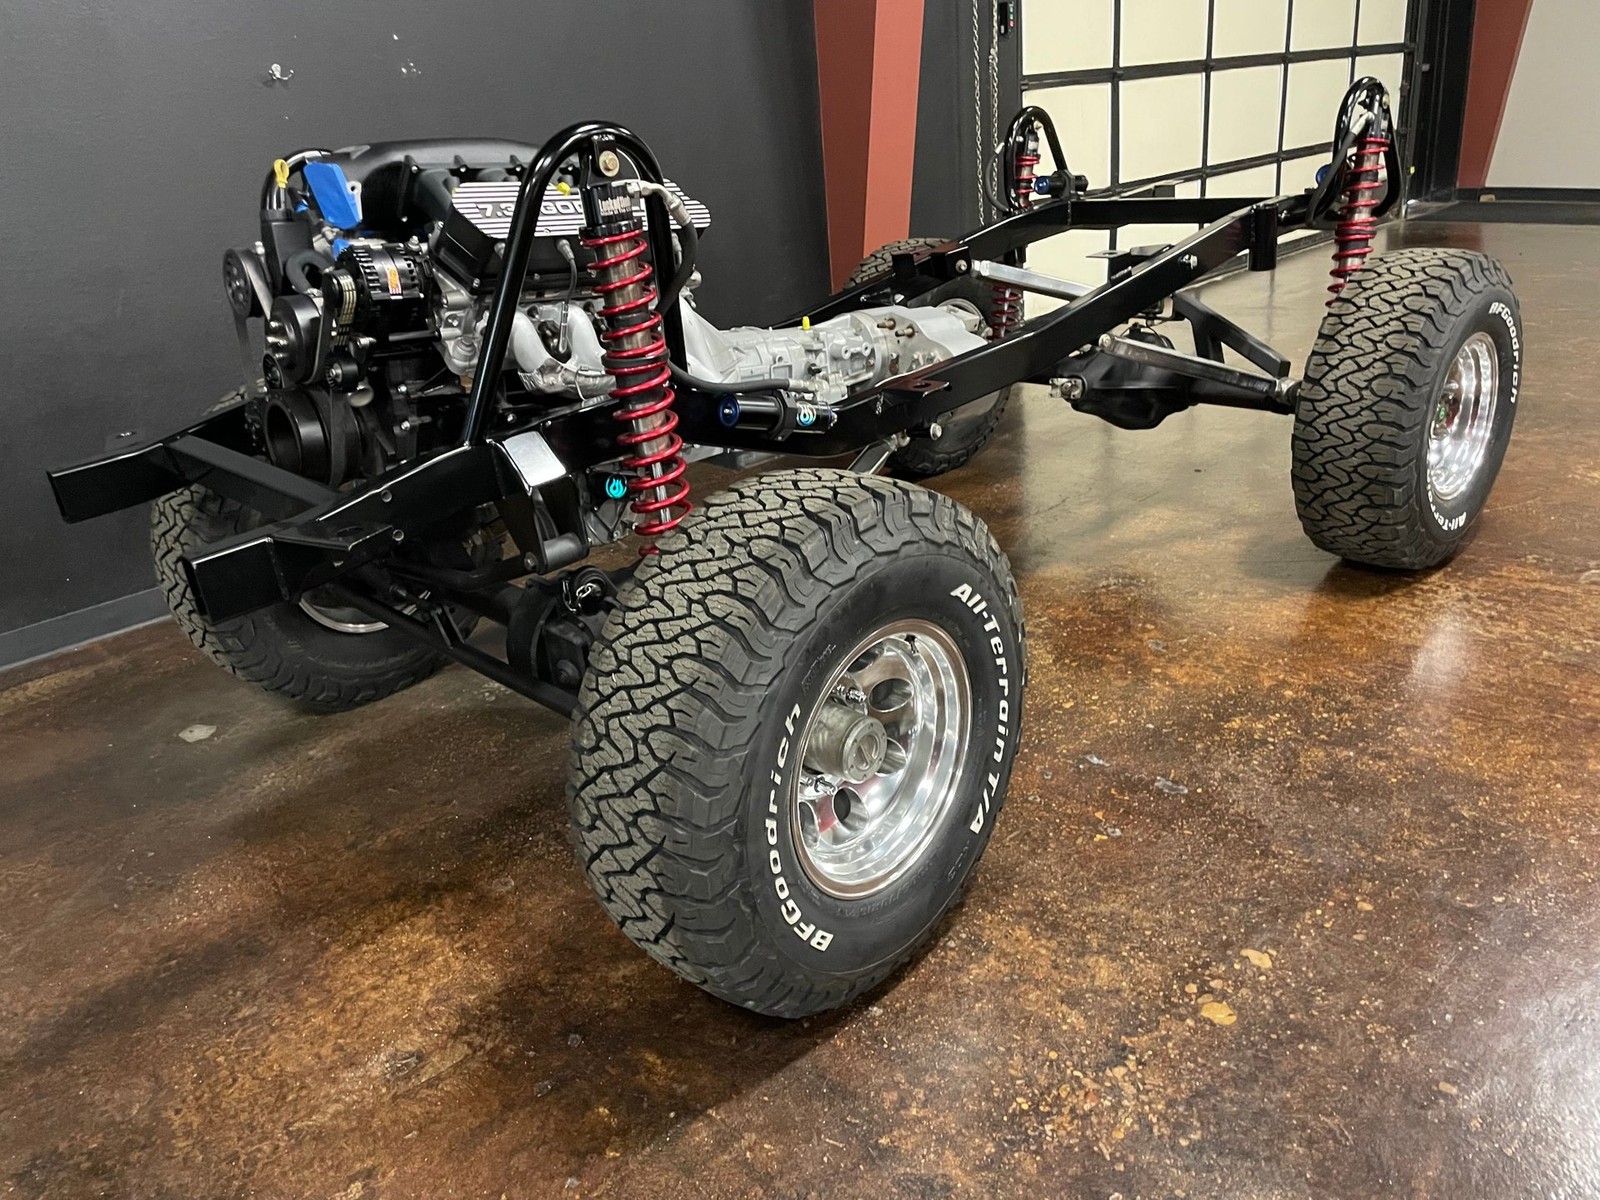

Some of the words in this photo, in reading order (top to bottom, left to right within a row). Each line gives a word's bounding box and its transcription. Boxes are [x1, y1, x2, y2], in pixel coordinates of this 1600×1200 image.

[1488, 301, 1520, 404] BFGoodrich
[950, 583, 1009, 763] All-Terrain
[766, 703, 834, 951] BFGoodrich
[969, 772, 1000, 834] T/A
